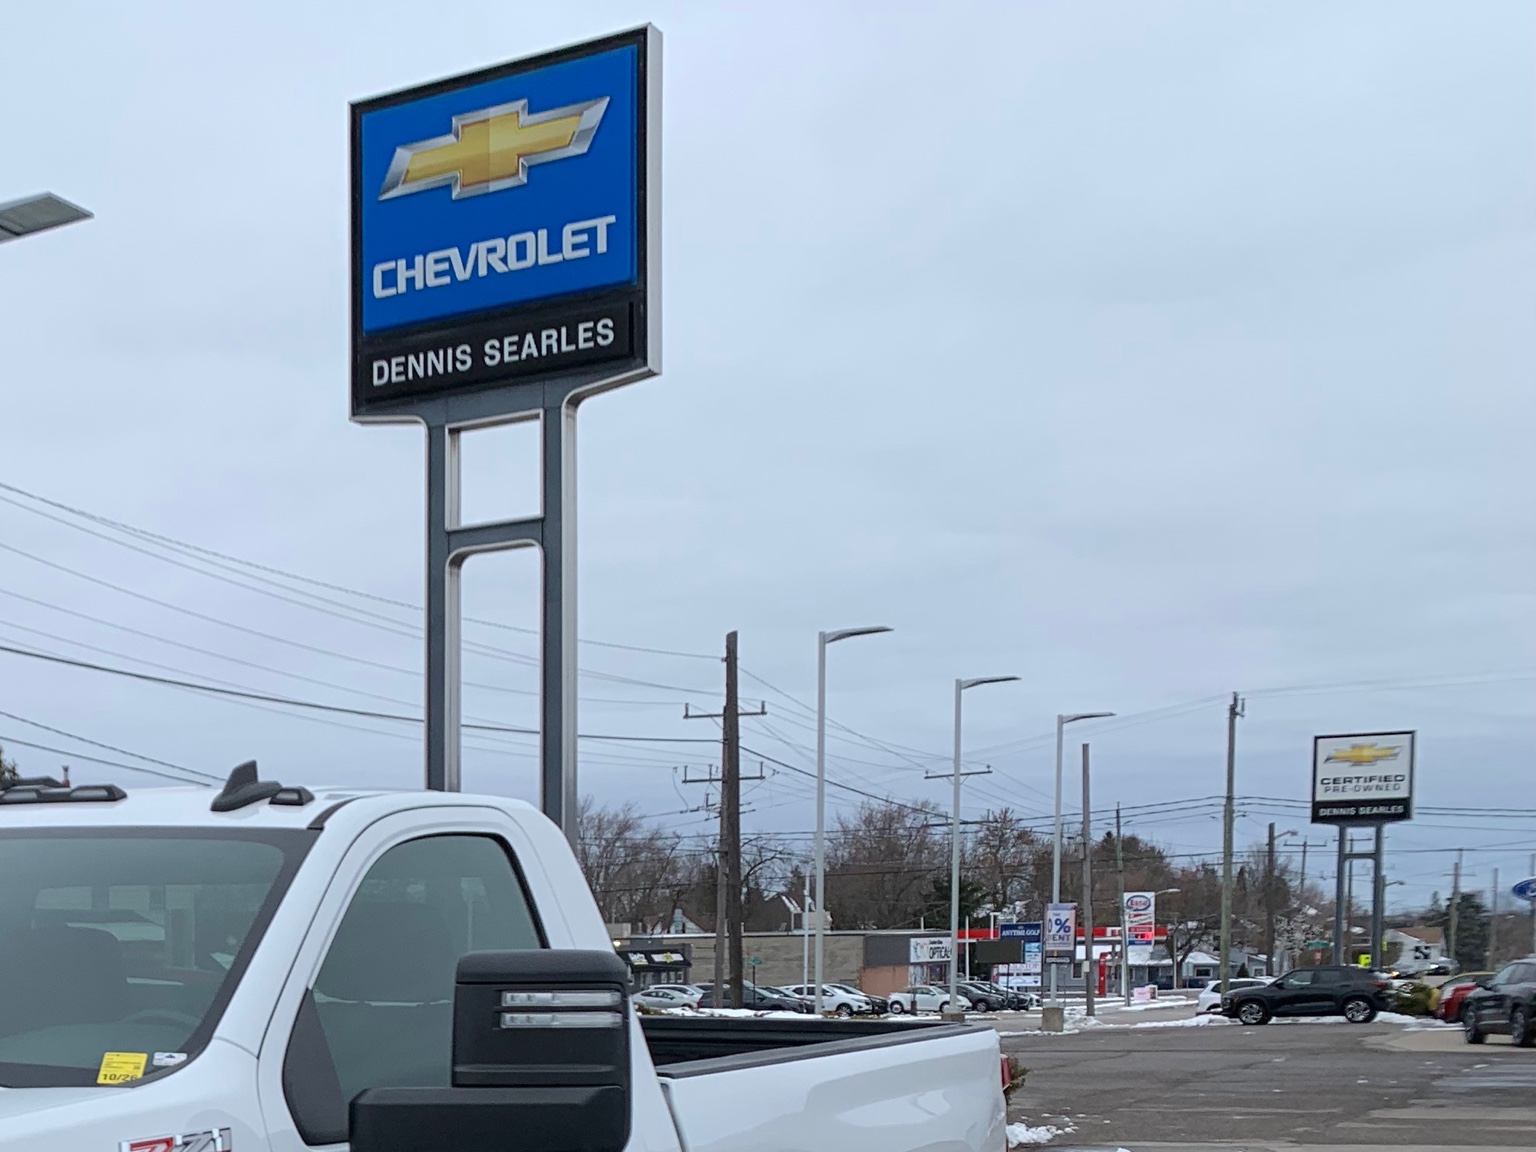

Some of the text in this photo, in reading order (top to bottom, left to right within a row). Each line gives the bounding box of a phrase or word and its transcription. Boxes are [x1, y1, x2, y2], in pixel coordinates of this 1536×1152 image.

[373, 215, 616, 299] CHEVROLET
[372, 317, 615, 387] DENNIS SEARLES
[1320, 774, 1406, 785] CERTIFIED
[1324, 783, 1401, 793] PRE-OWNED
[1319, 805, 1404, 816] DENNIS SEARLES
